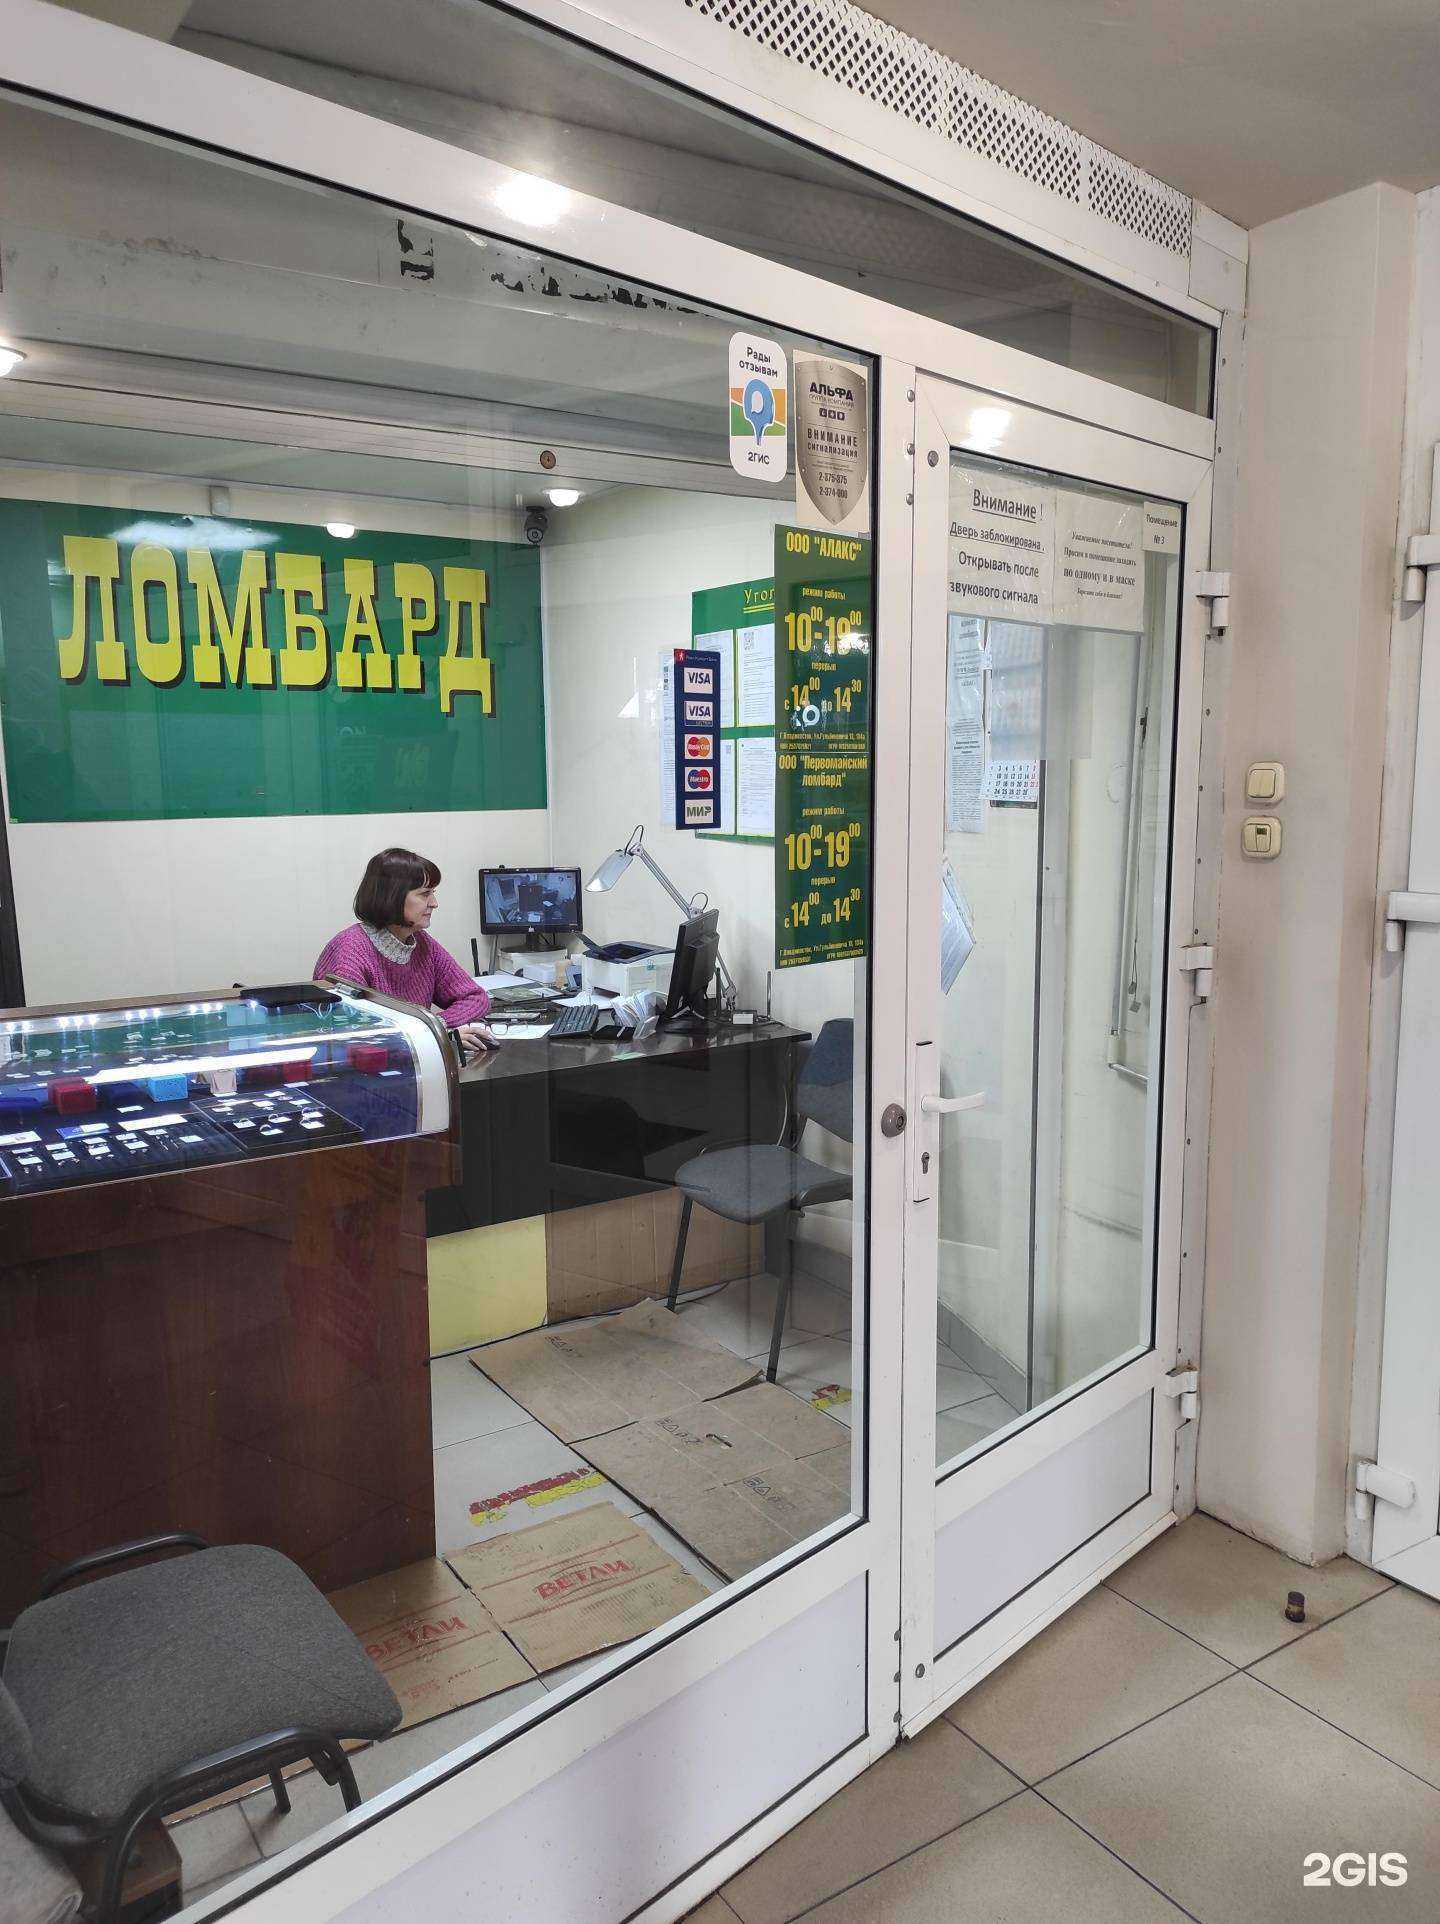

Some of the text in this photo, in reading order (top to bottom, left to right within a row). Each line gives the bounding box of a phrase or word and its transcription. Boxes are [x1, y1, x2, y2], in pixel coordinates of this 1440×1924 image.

[747, 347, 770, 363] Рады
[738, 360, 778, 378] отзывам
[810, 382, 854, 401] АЛЬФА
[808, 428, 858, 447] ВНИМАНИЕ
[748, 452, 770, 464] 2ГИС
[950, 522, 978, 540] Дверь
[786, 532, 862, 560] ООО "АЛАКС"
[958, 551, 1039, 578] Открывать после
[949, 582, 1038, 604] звукового сигнала
[58, 535, 494, 716] ЛОМБАРД
[688, 672, 711, 684] VISA
[688, 706, 711, 716] VISA
[779, 754, 868, 772] ООО "Первомайский
[802, 772, 846, 788] ломбард"
[686, 806, 712, 817] МИР
[820, 913, 832, 926] до
